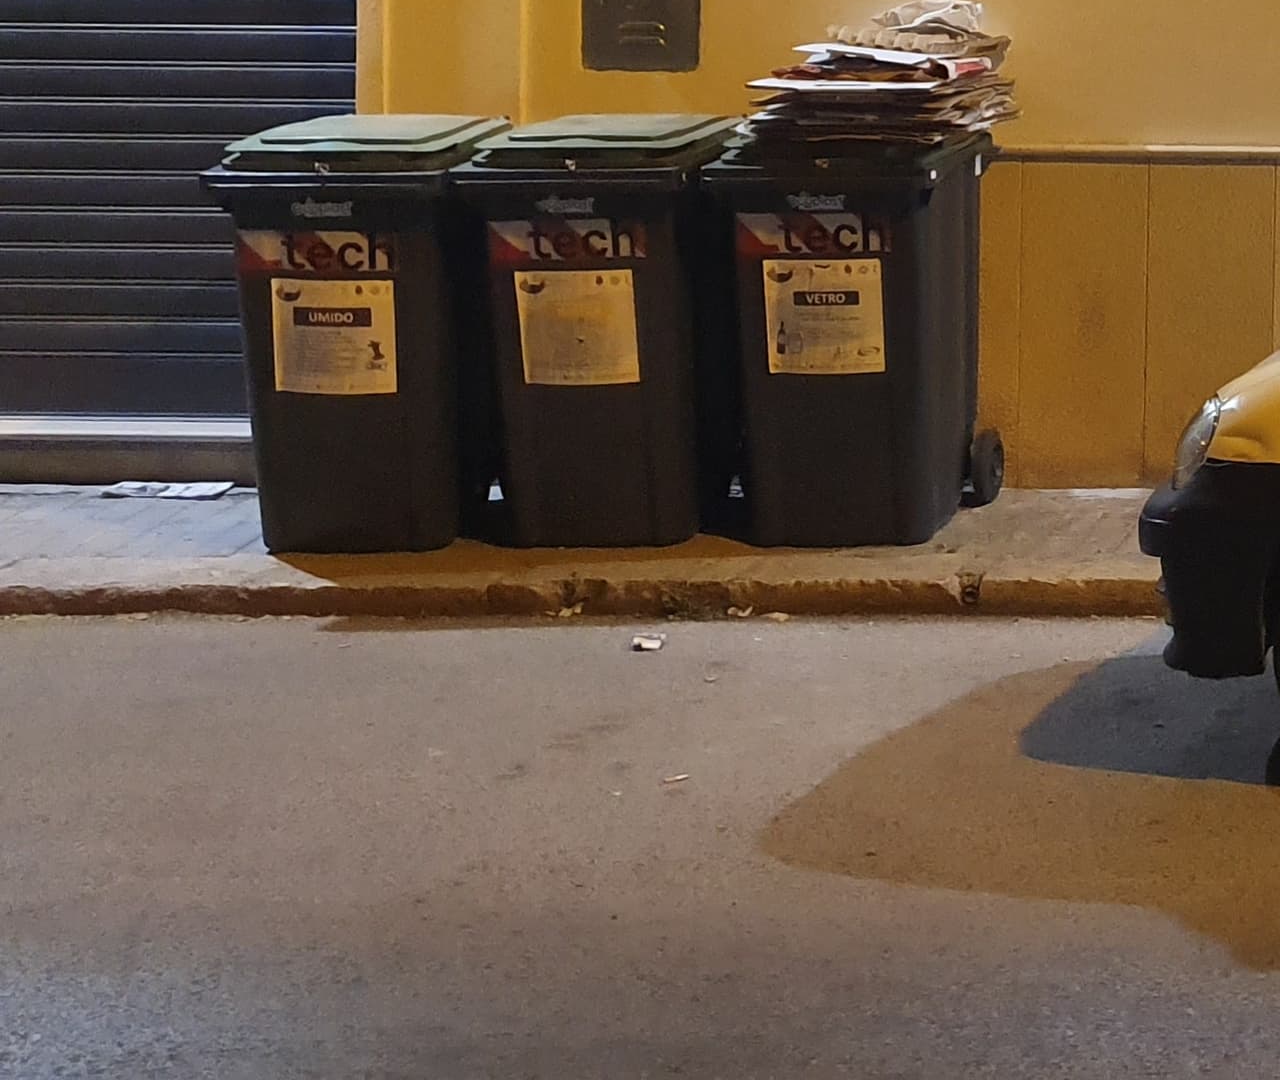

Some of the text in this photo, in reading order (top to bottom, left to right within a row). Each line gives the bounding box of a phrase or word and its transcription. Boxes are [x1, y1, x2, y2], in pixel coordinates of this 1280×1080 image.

[281, 229, 394, 271] tech
[527, 219, 635, 258] tech
[778, 214, 885, 252] tech
[308, 311, 354, 323] UMIDO
[805, 293, 846, 304] VETRO
